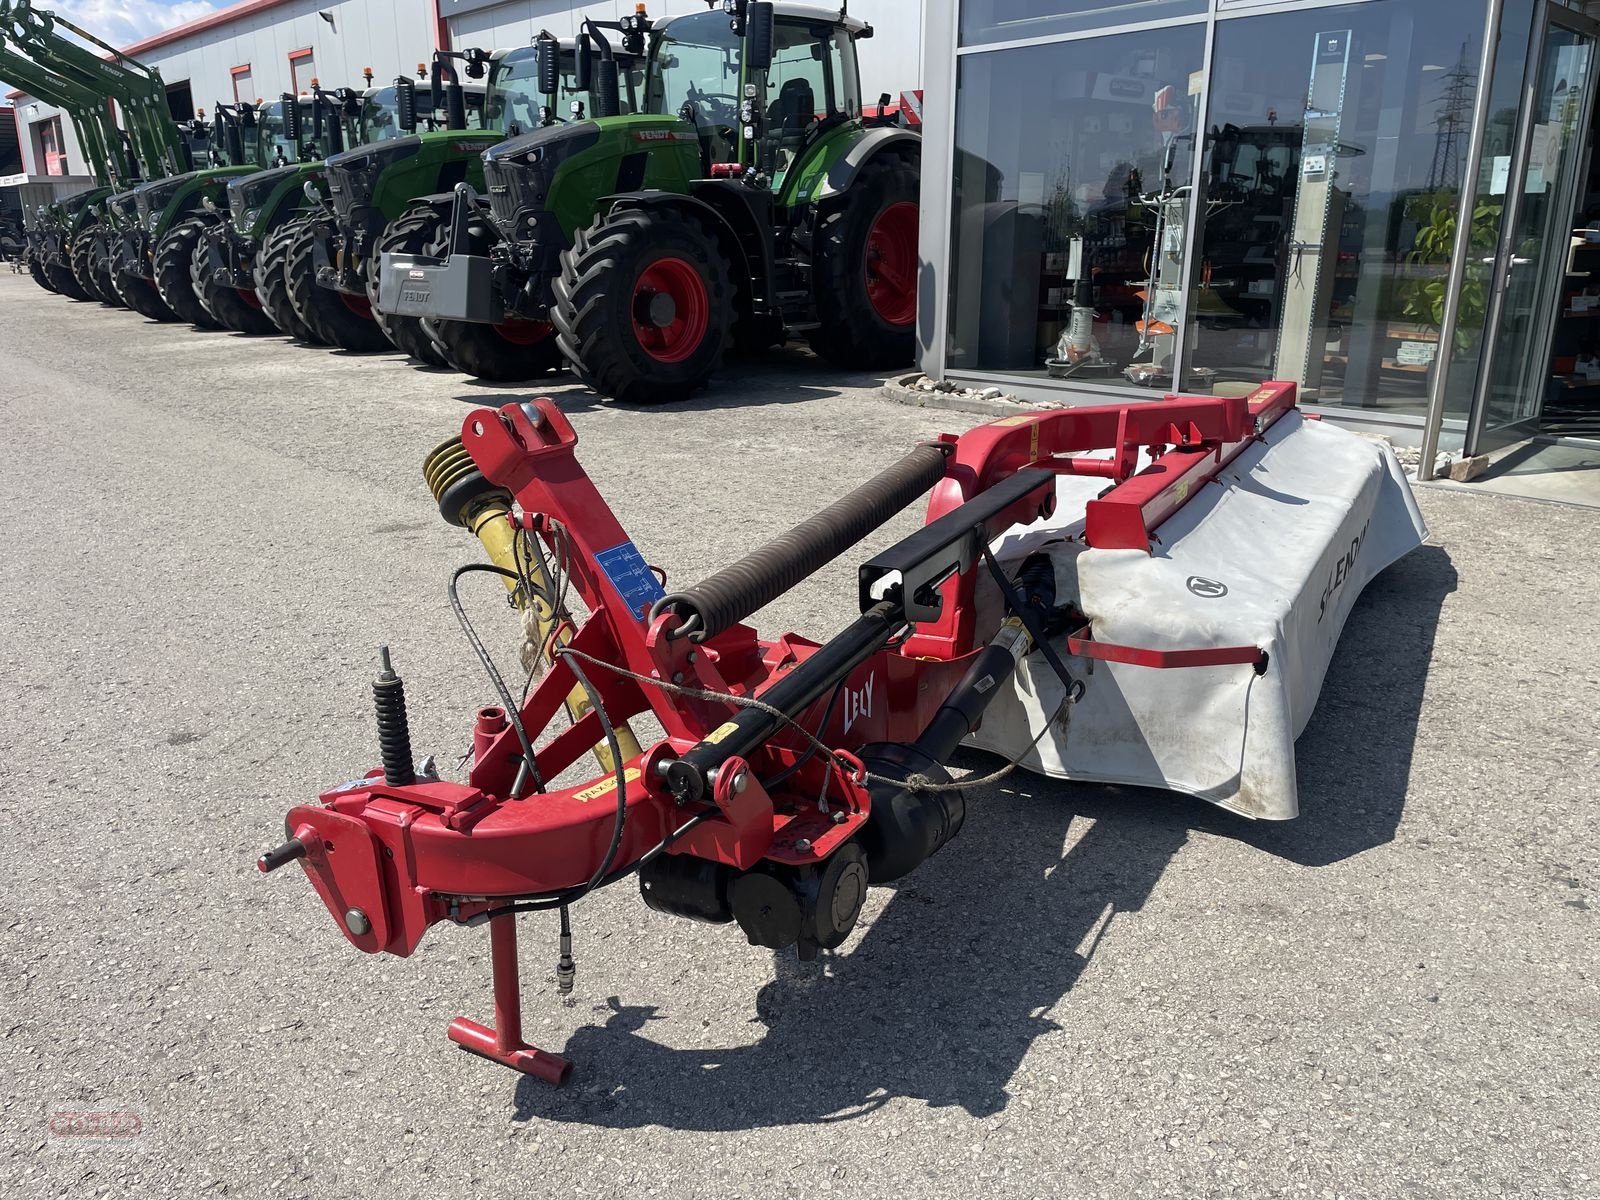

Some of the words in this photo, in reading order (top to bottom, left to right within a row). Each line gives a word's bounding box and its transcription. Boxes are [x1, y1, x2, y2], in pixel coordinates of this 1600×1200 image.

[99, 63, 126, 79] FENDT
[43, 75, 69, 89] FENDT
[639, 129, 671, 140] FENDT
[403, 289, 431, 303] FENDT
[844, 670, 875, 736] LELY
[579, 784, 606, 800] MAX
